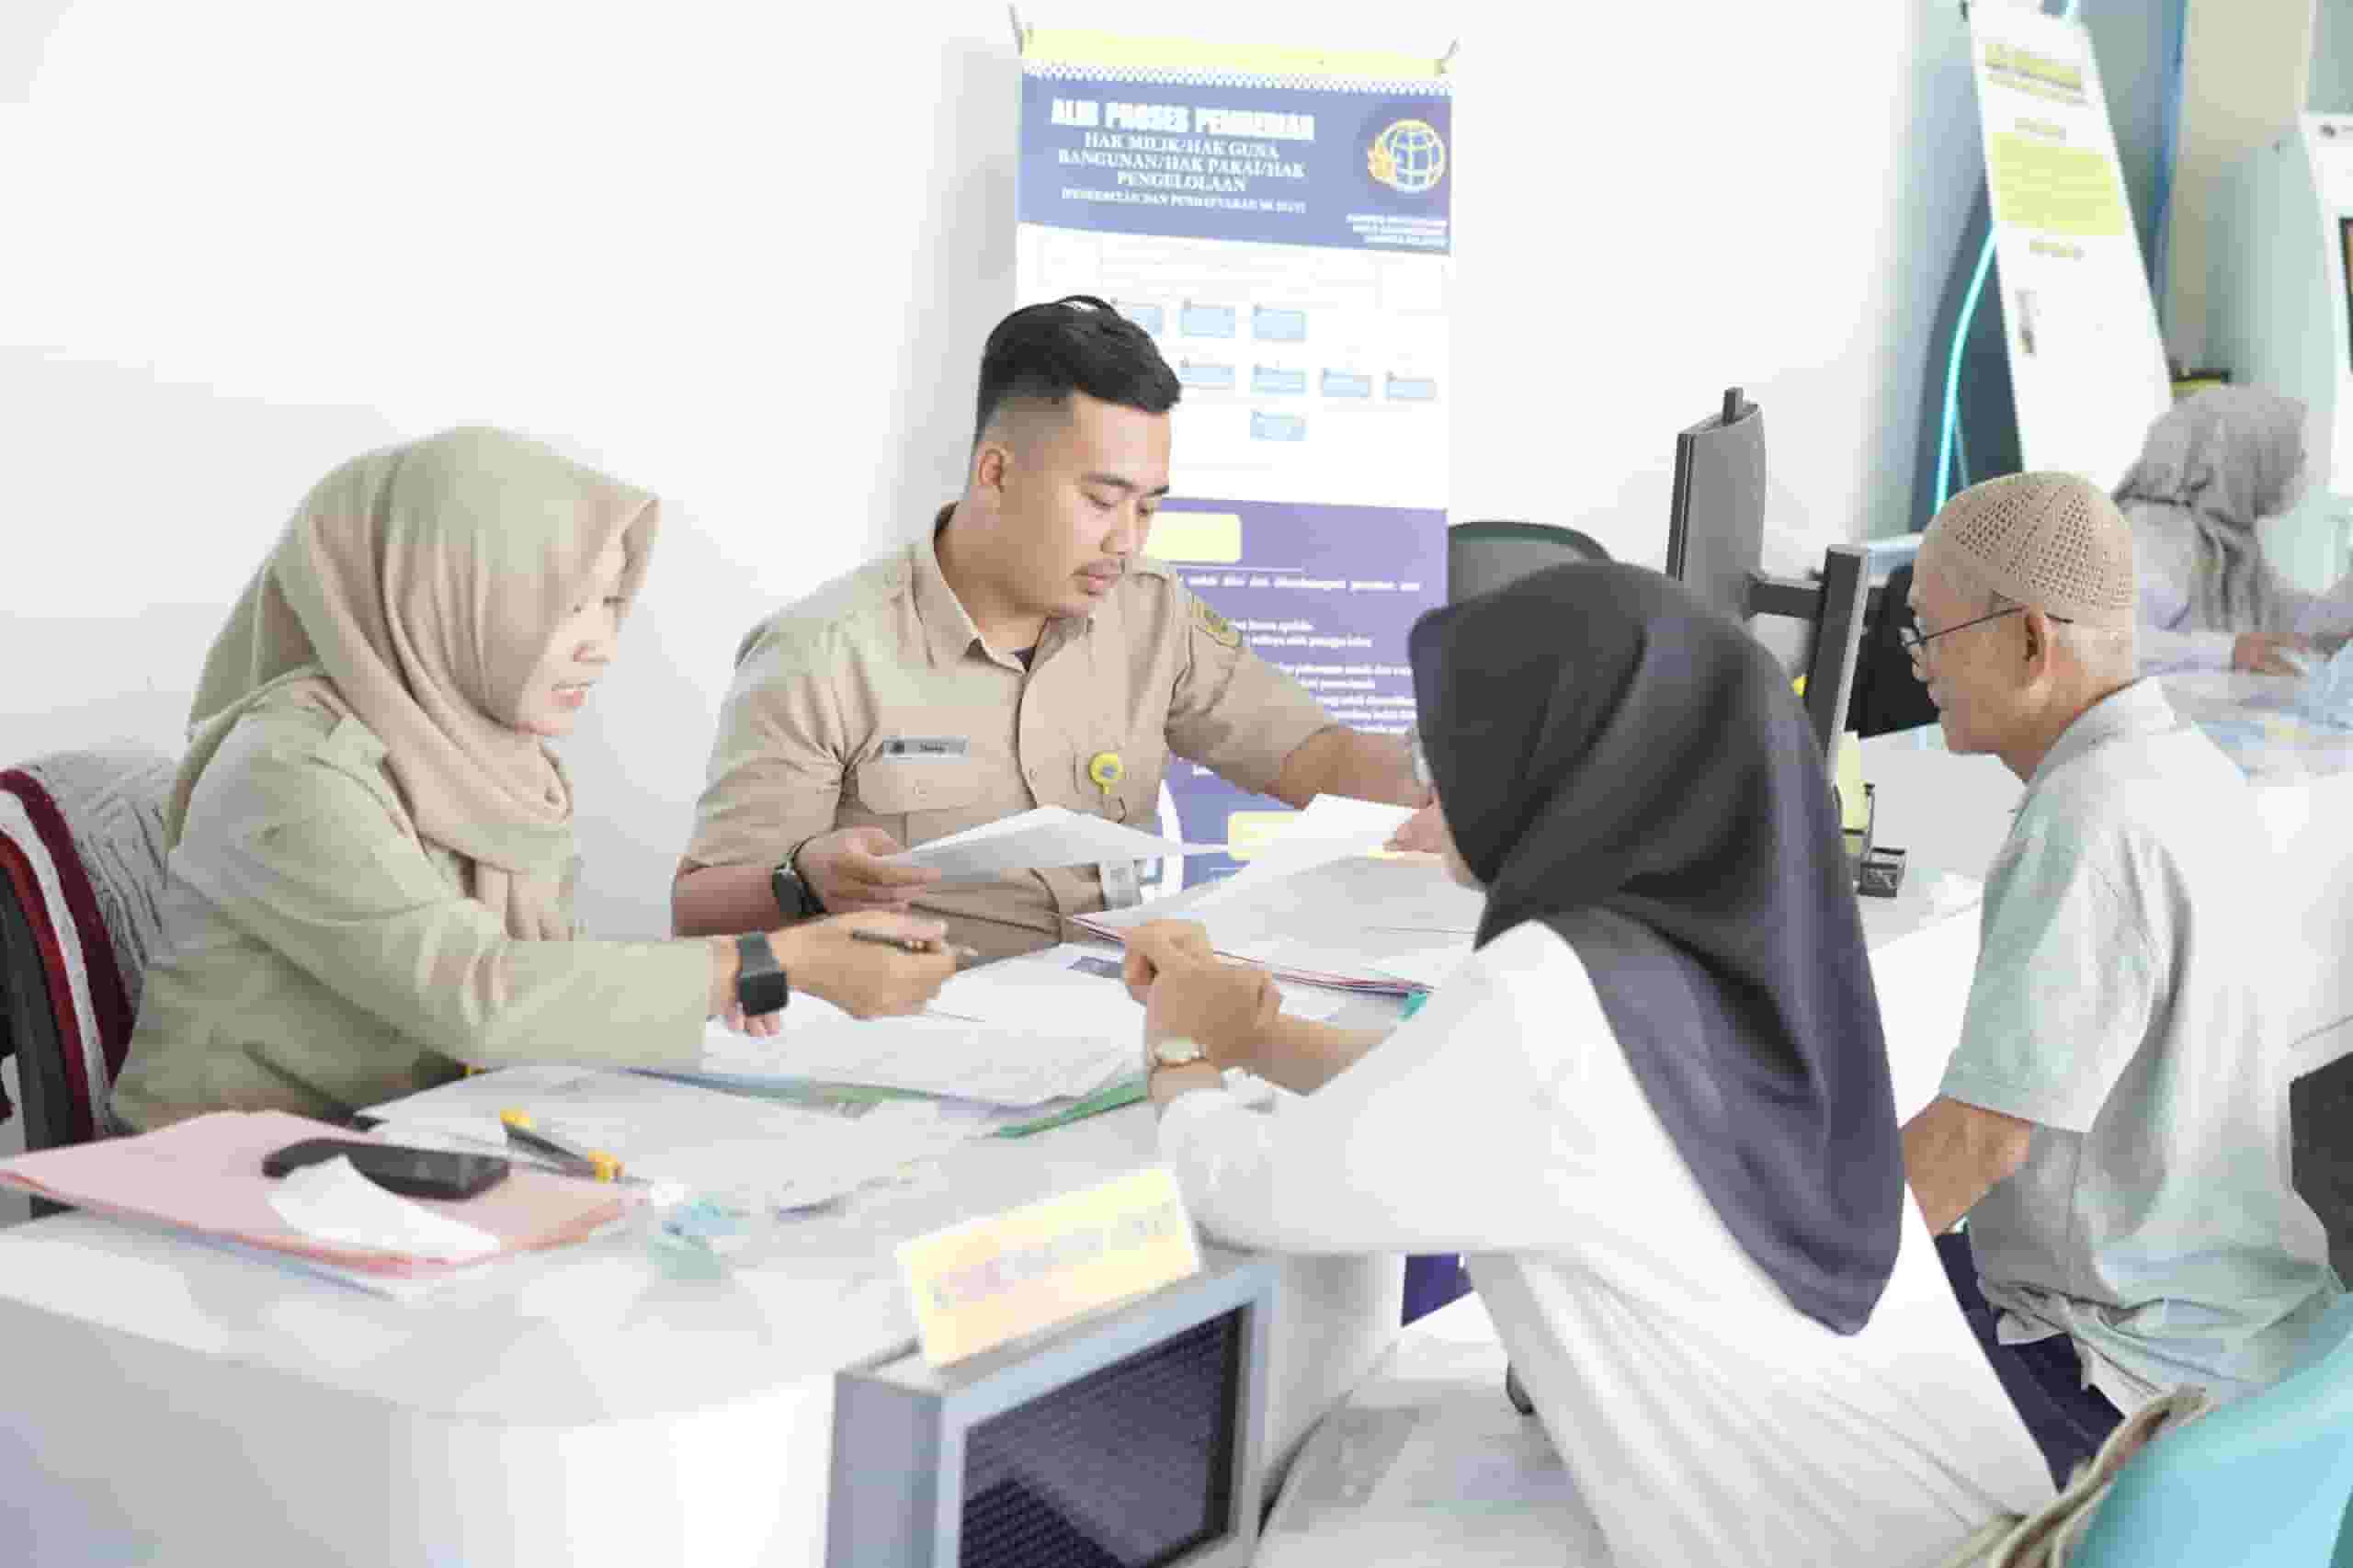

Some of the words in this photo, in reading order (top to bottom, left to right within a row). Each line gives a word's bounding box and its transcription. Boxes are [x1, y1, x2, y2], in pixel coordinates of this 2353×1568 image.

[1051, 98, 1098, 126] AL
[1086, 132, 1122, 149] HAK
[1229, 142, 1279, 160] GUNA
